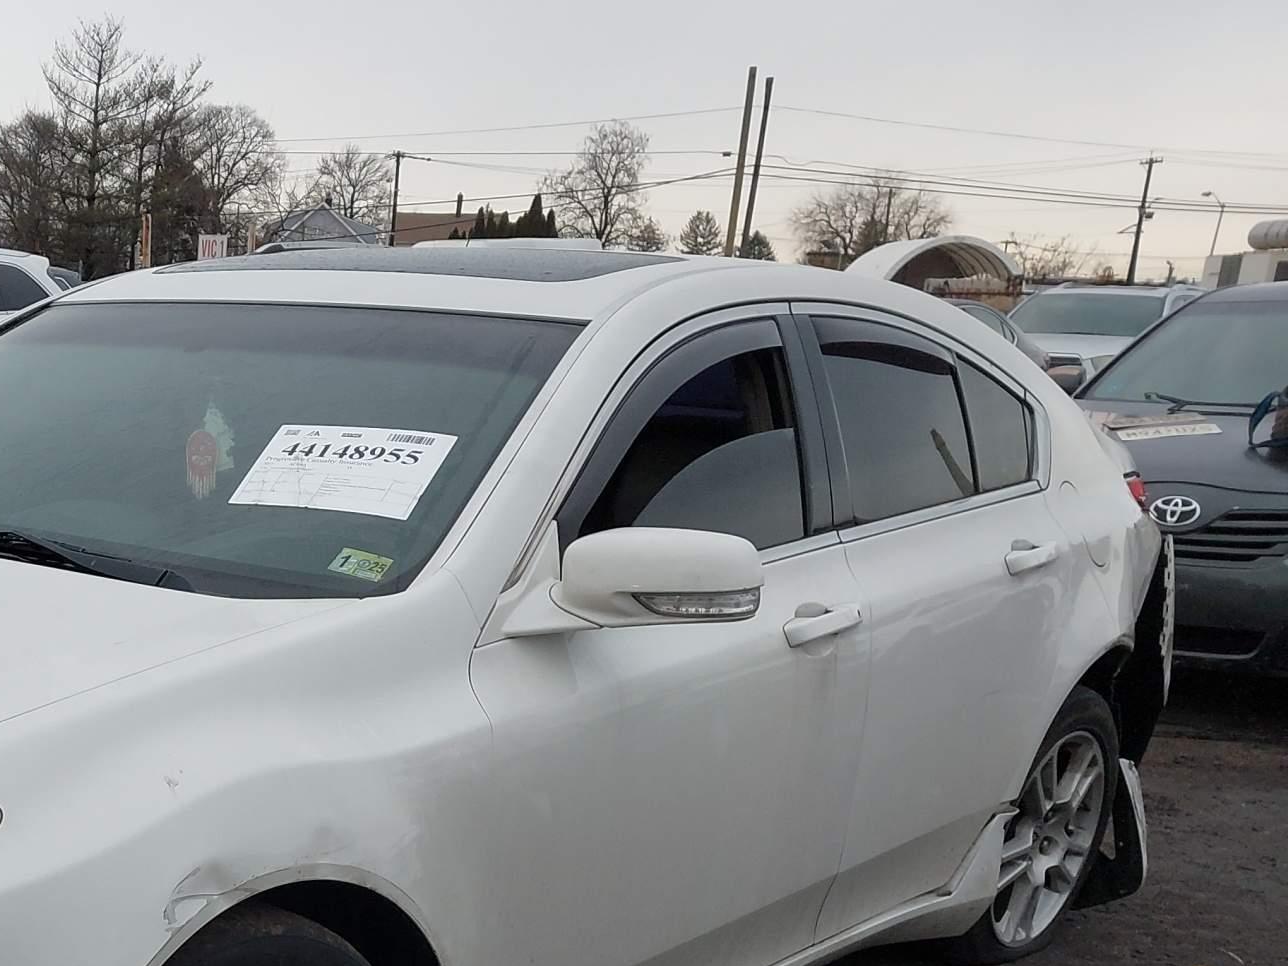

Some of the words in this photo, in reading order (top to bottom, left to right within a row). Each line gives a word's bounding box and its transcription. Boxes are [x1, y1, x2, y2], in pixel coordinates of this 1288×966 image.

[201, 239, 217, 258] VIC
[281, 442, 424, 465] 44148955
[306, 457, 336, 465] Casualty
[338, 459, 374, 467] Insurance
[339, 554, 352, 568] 1
[367, 561, 388, 574] 25
